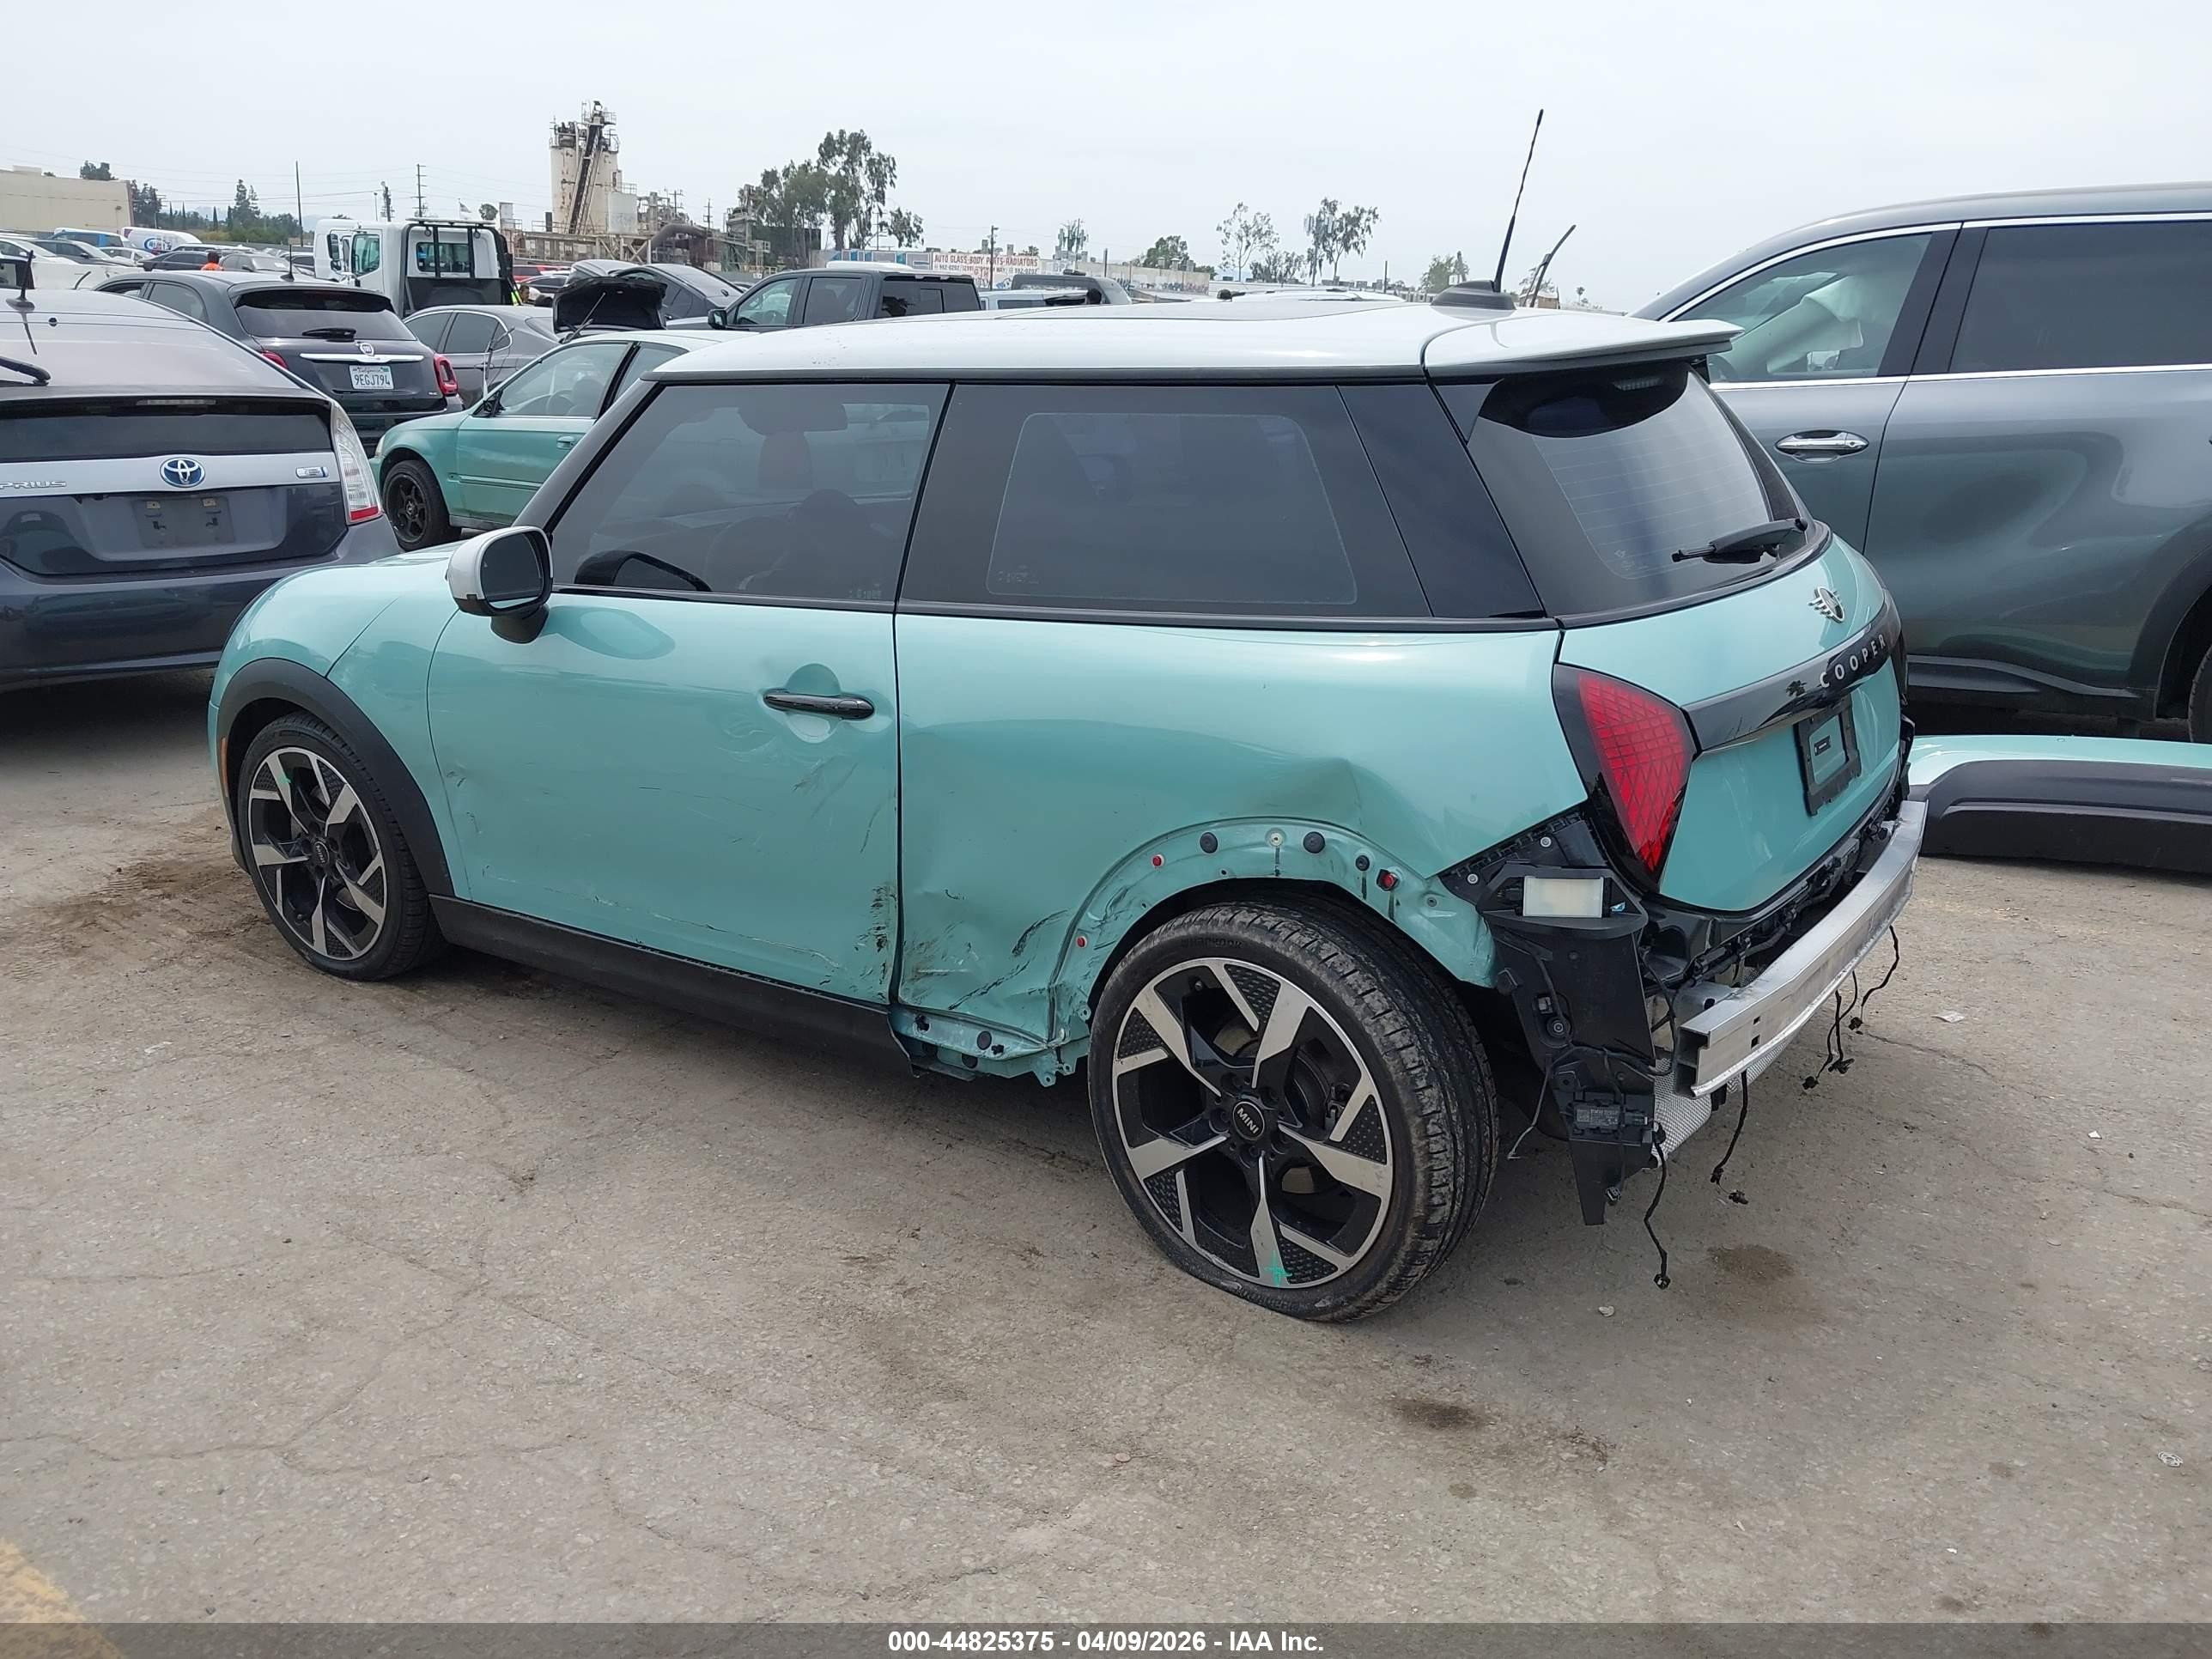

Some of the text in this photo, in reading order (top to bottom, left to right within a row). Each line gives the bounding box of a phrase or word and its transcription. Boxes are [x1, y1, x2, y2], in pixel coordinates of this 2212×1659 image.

[934, 254, 949, 263] AUTO
[354, 374, 391, 386] 9EGJ794
[0, 481, 67, 489] PRIUS
[1820, 634, 1887, 688] COOPER
[1237, 1108, 1260, 1133] MINI
